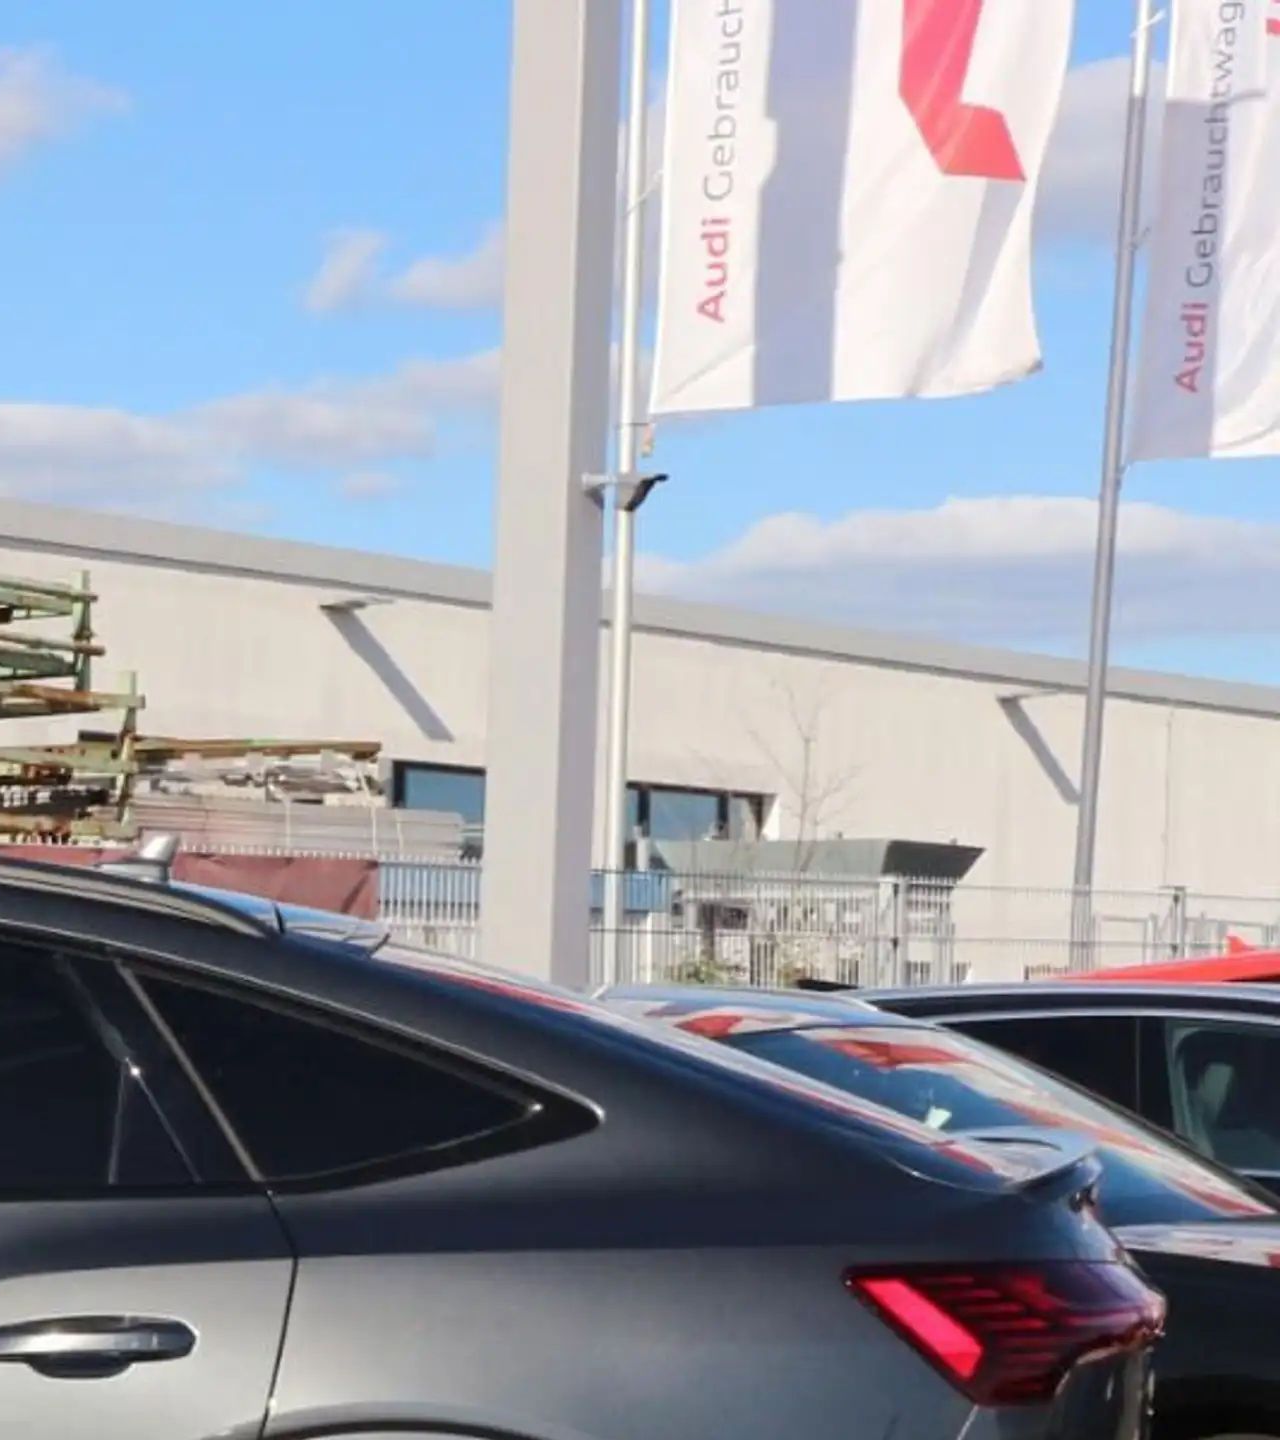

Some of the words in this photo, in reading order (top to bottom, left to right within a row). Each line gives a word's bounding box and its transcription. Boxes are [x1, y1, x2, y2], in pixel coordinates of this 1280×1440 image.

[1185, 1, 1244, 287] Gebrauchtwag
[697, 216, 730, 323] Audi
[1175, 302, 1208, 392] Audi
